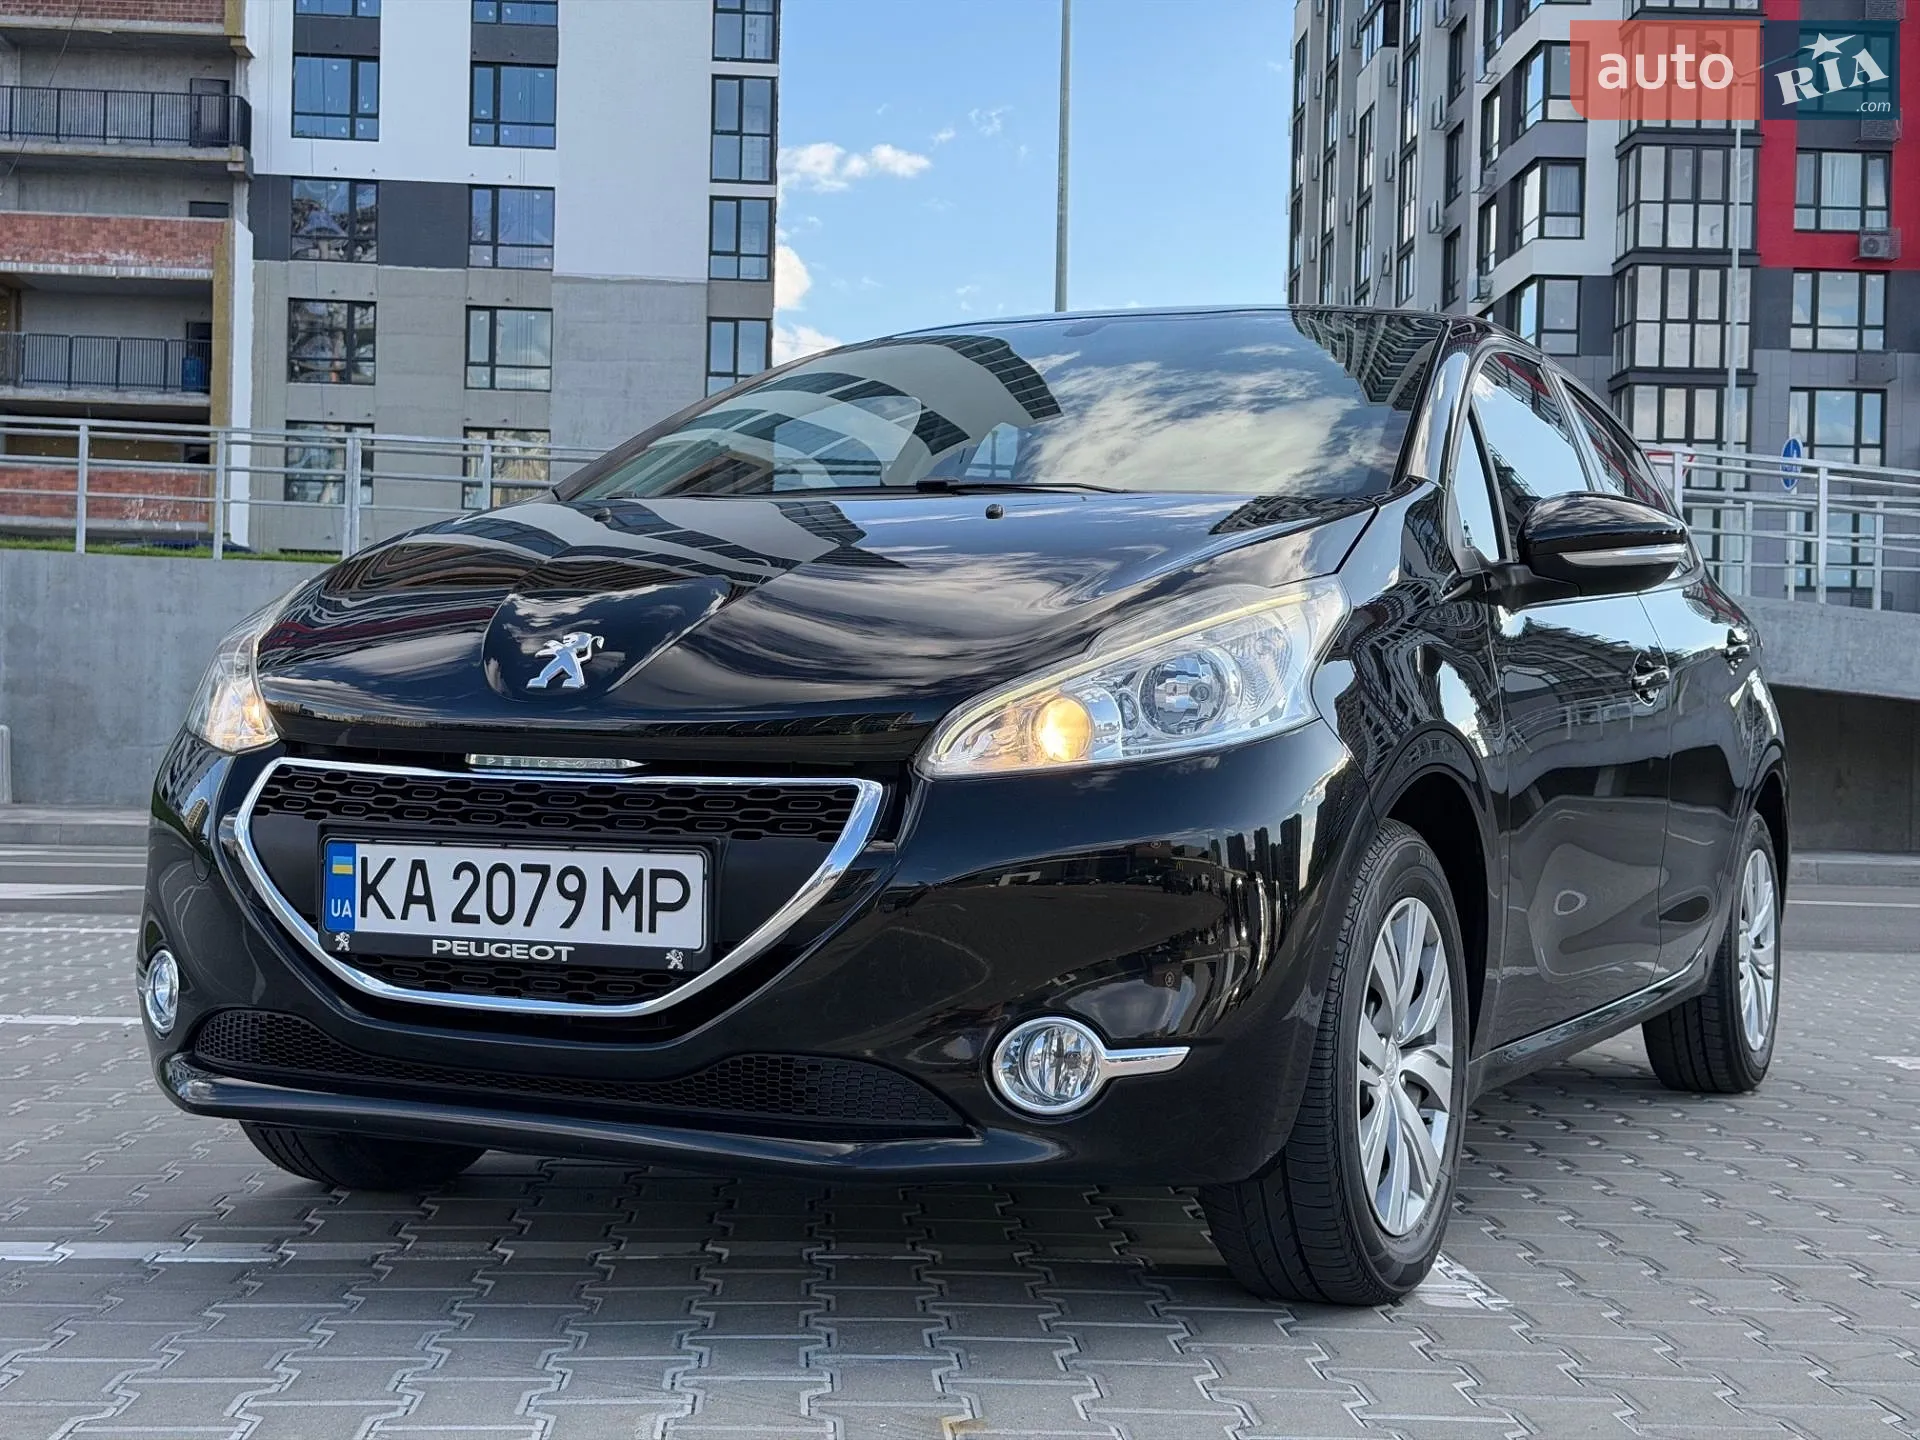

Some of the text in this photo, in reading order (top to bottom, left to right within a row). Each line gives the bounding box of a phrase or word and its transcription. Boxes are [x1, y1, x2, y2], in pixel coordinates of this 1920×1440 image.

[360, 856, 691, 934] KA 2079 MP
[331, 898, 352, 919] UA
[432, 939, 575, 962] PEUGEOT
